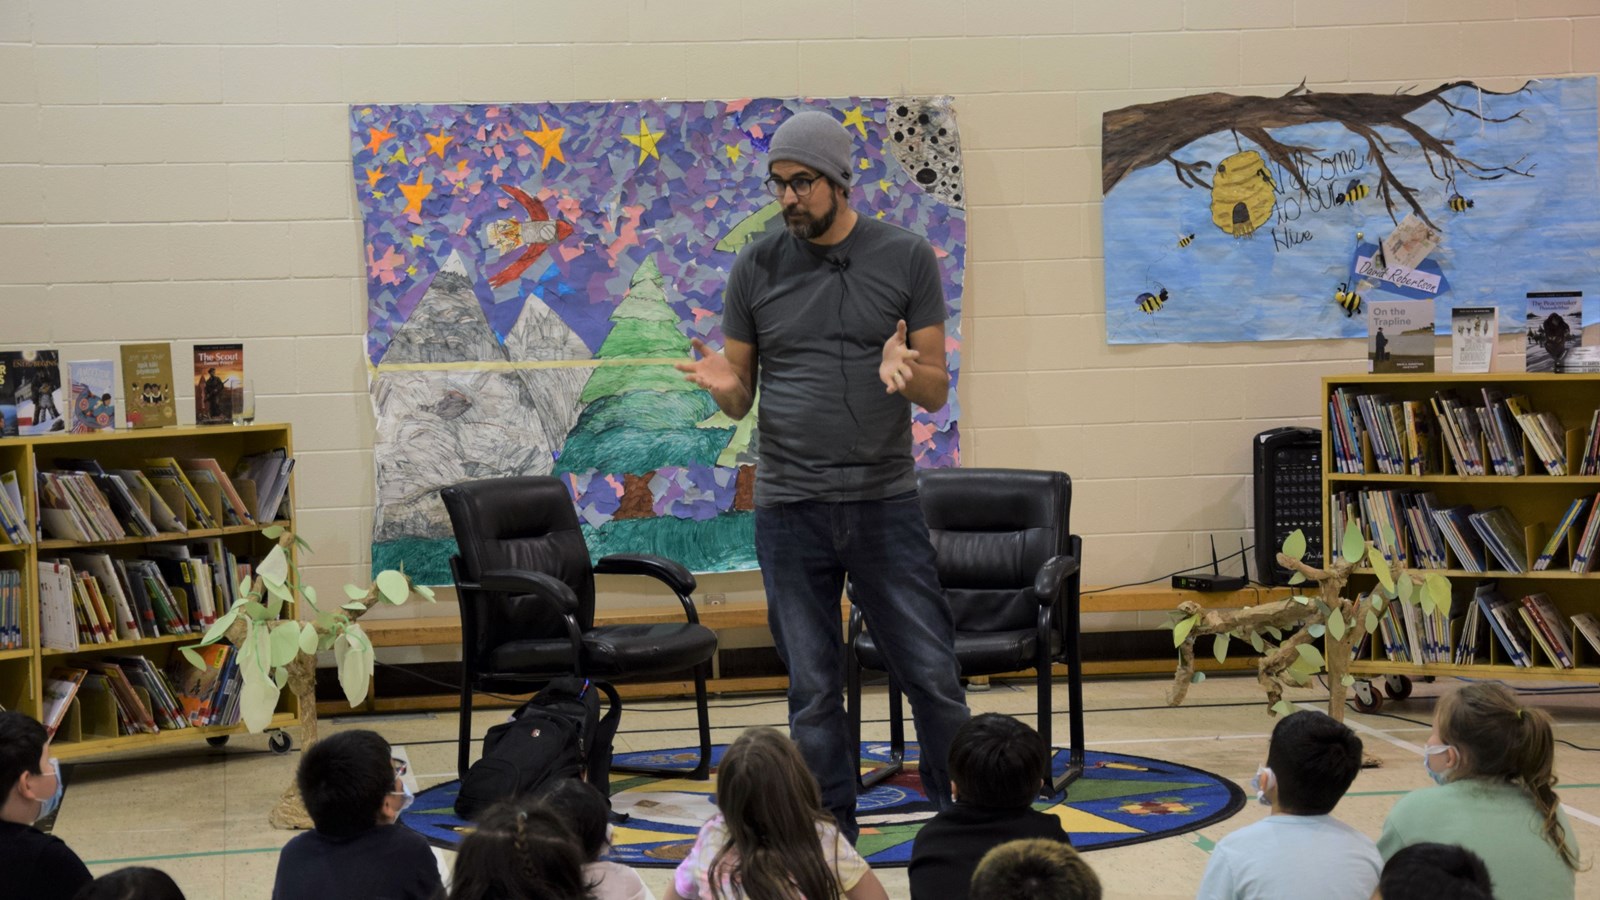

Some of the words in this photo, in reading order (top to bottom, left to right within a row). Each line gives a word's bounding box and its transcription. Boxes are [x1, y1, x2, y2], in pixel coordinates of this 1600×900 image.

[1274, 196, 1301, 225] to
[1271, 228, 1313, 251] Hive
[1359, 261, 1389, 278] David
[1389, 268, 1437, 293] Robertson
[1373, 307, 1388, 316] On
[1390, 307, 1406, 315] the
[1373, 316, 1412, 327] Trapline
[198, 352, 214, 361] The
[215, 352, 238, 361] Scout
